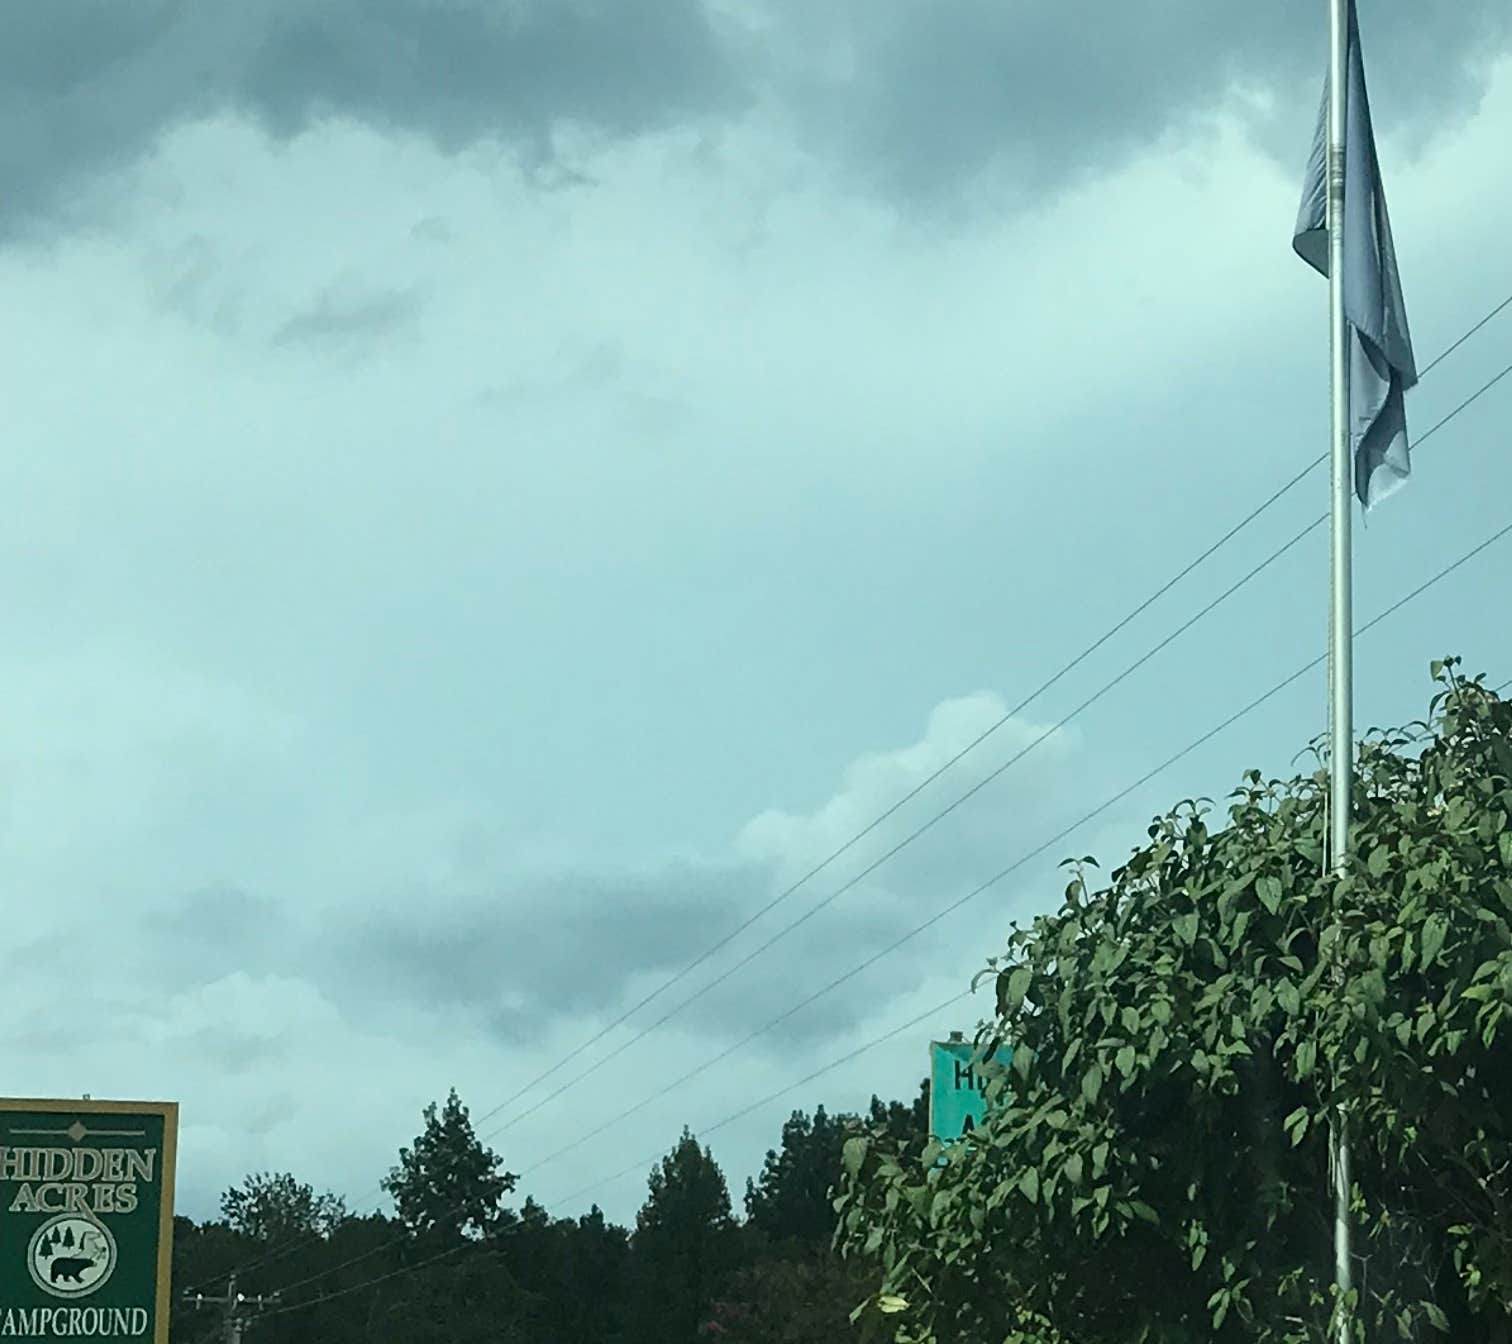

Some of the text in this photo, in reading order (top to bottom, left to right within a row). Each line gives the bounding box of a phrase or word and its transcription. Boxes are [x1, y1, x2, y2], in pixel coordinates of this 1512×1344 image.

[0, 1146, 156, 1182] HIDDEN
[9, 1182, 139, 1215] ACRES
[0, 1306, 148, 1336] AMPGROUND
